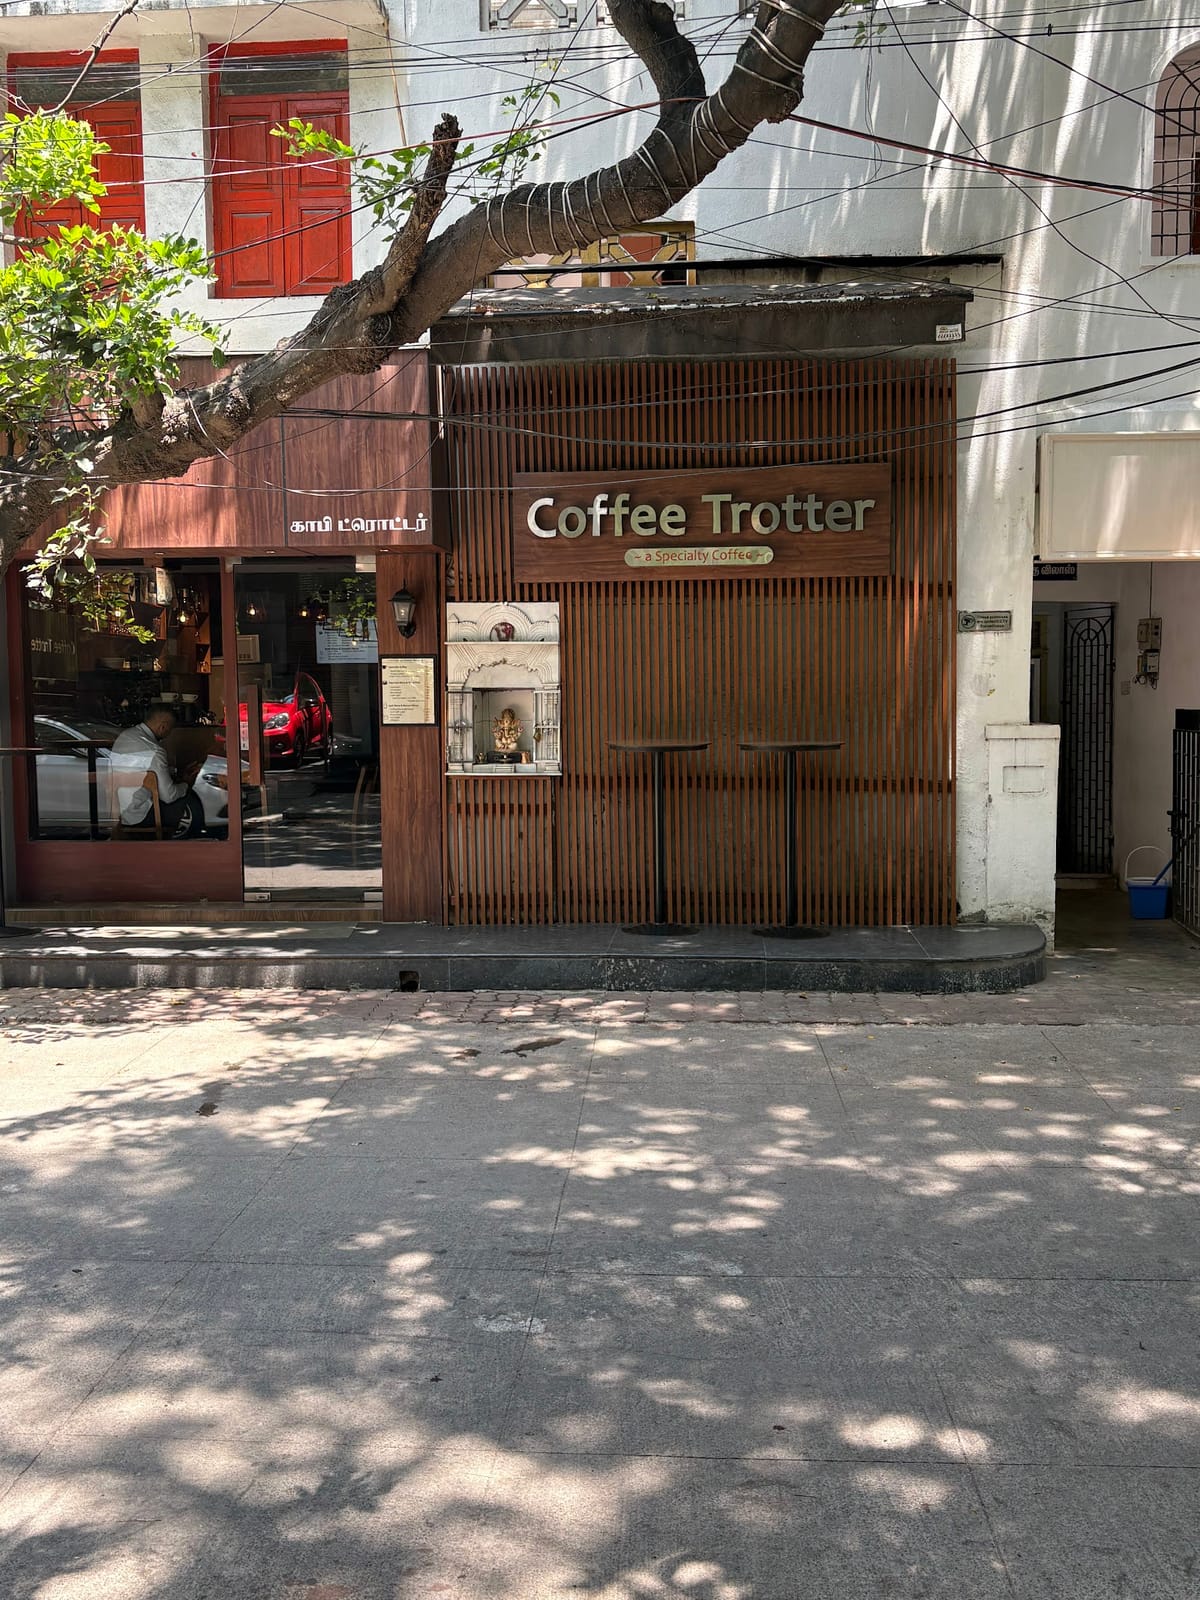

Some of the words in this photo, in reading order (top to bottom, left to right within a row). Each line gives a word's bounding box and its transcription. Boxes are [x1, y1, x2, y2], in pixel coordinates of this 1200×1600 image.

[290, 516, 333, 533] காபி
[337, 512, 429, 534] ட்ரொட்டர்
[526, 493, 687, 540] Coffee
[701, 492, 877, 536] Trotter
[644, 552, 653, 562] a
[655, 550, 709, 564] Specialty
[711, 548, 753, 561] Coffee
